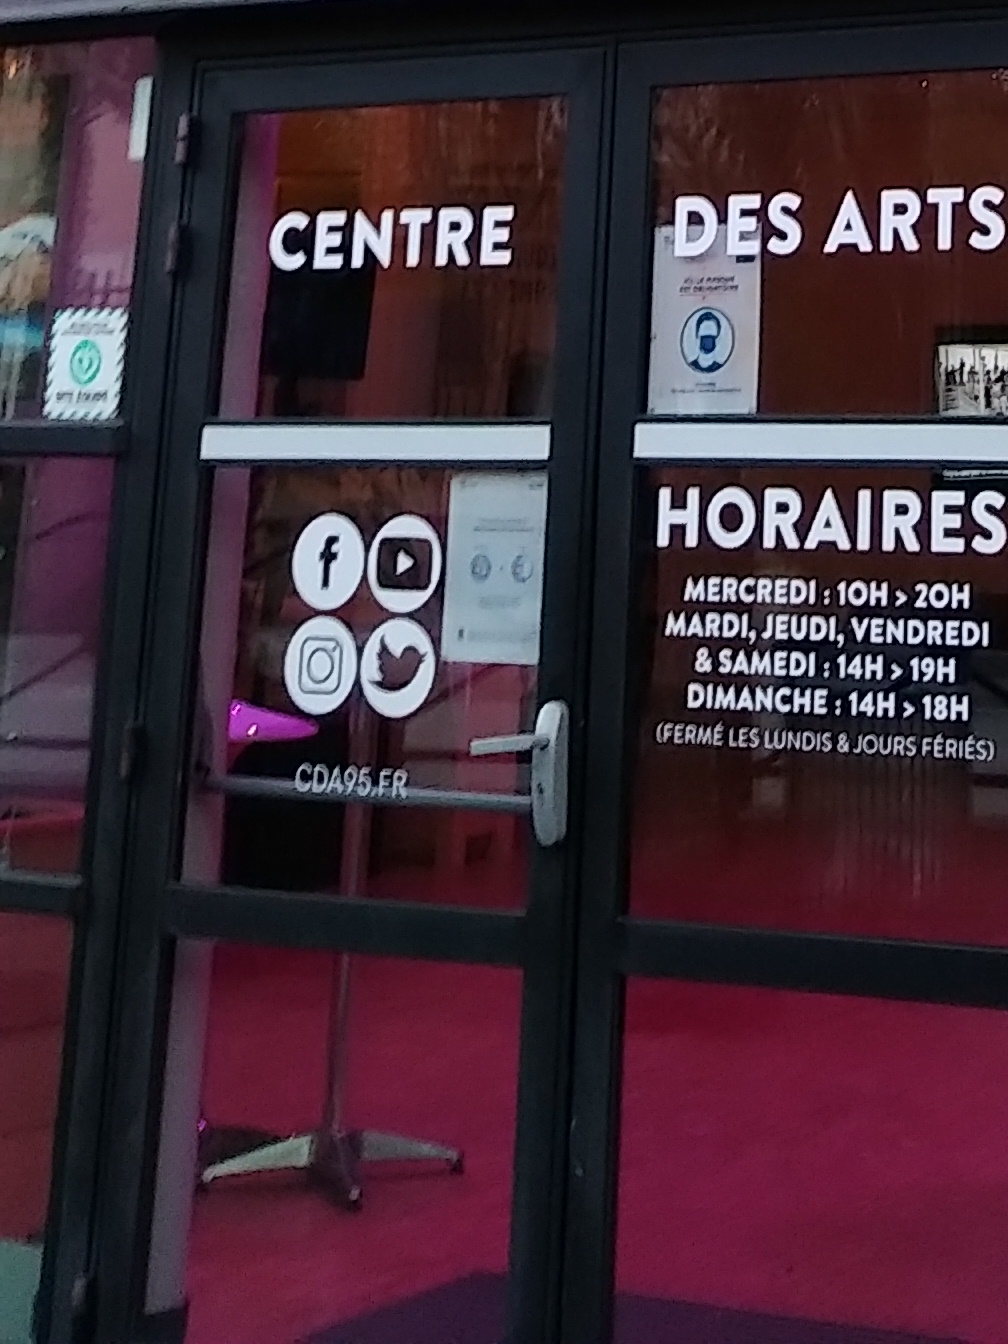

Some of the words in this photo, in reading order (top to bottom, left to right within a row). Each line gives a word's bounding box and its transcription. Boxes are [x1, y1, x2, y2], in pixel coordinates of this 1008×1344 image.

[269, 205, 515, 271] CENTRE
[673, 192, 803, 257] DES
[823, 185, 1006, 253] ARTS
[656, 485, 1007, 554] HORAIRES
[683, 575, 817, 605] MERCREDI
[837, 580, 889, 607] 10H
[914, 582, 971, 609] 20H
[664, 610, 757, 645] MARDI,
[761, 613, 845, 648] JEUDI,
[850, 616, 990, 647] VENDREDI
[694, 647, 712, 673] &
[718, 648, 817, 678] SAMEDI
[837, 653, 884, 680] 14H
[910, 656, 956, 683] 19H
[687, 682, 828, 715] DIMANCHE
[848, 690, 896, 718] 14H
[922, 694, 969, 721] 18H
[656, 720, 725, 746] (FERMÉ
[729, 727, 760, 749] LES
[764, 728, 833, 753] LUNDIS
[837, 732, 850, 753] &
[853, 733, 916, 756] JOURS
[922, 732, 997, 761] FÉRIÉS)
[295, 762, 409, 799] CDA95.FR
